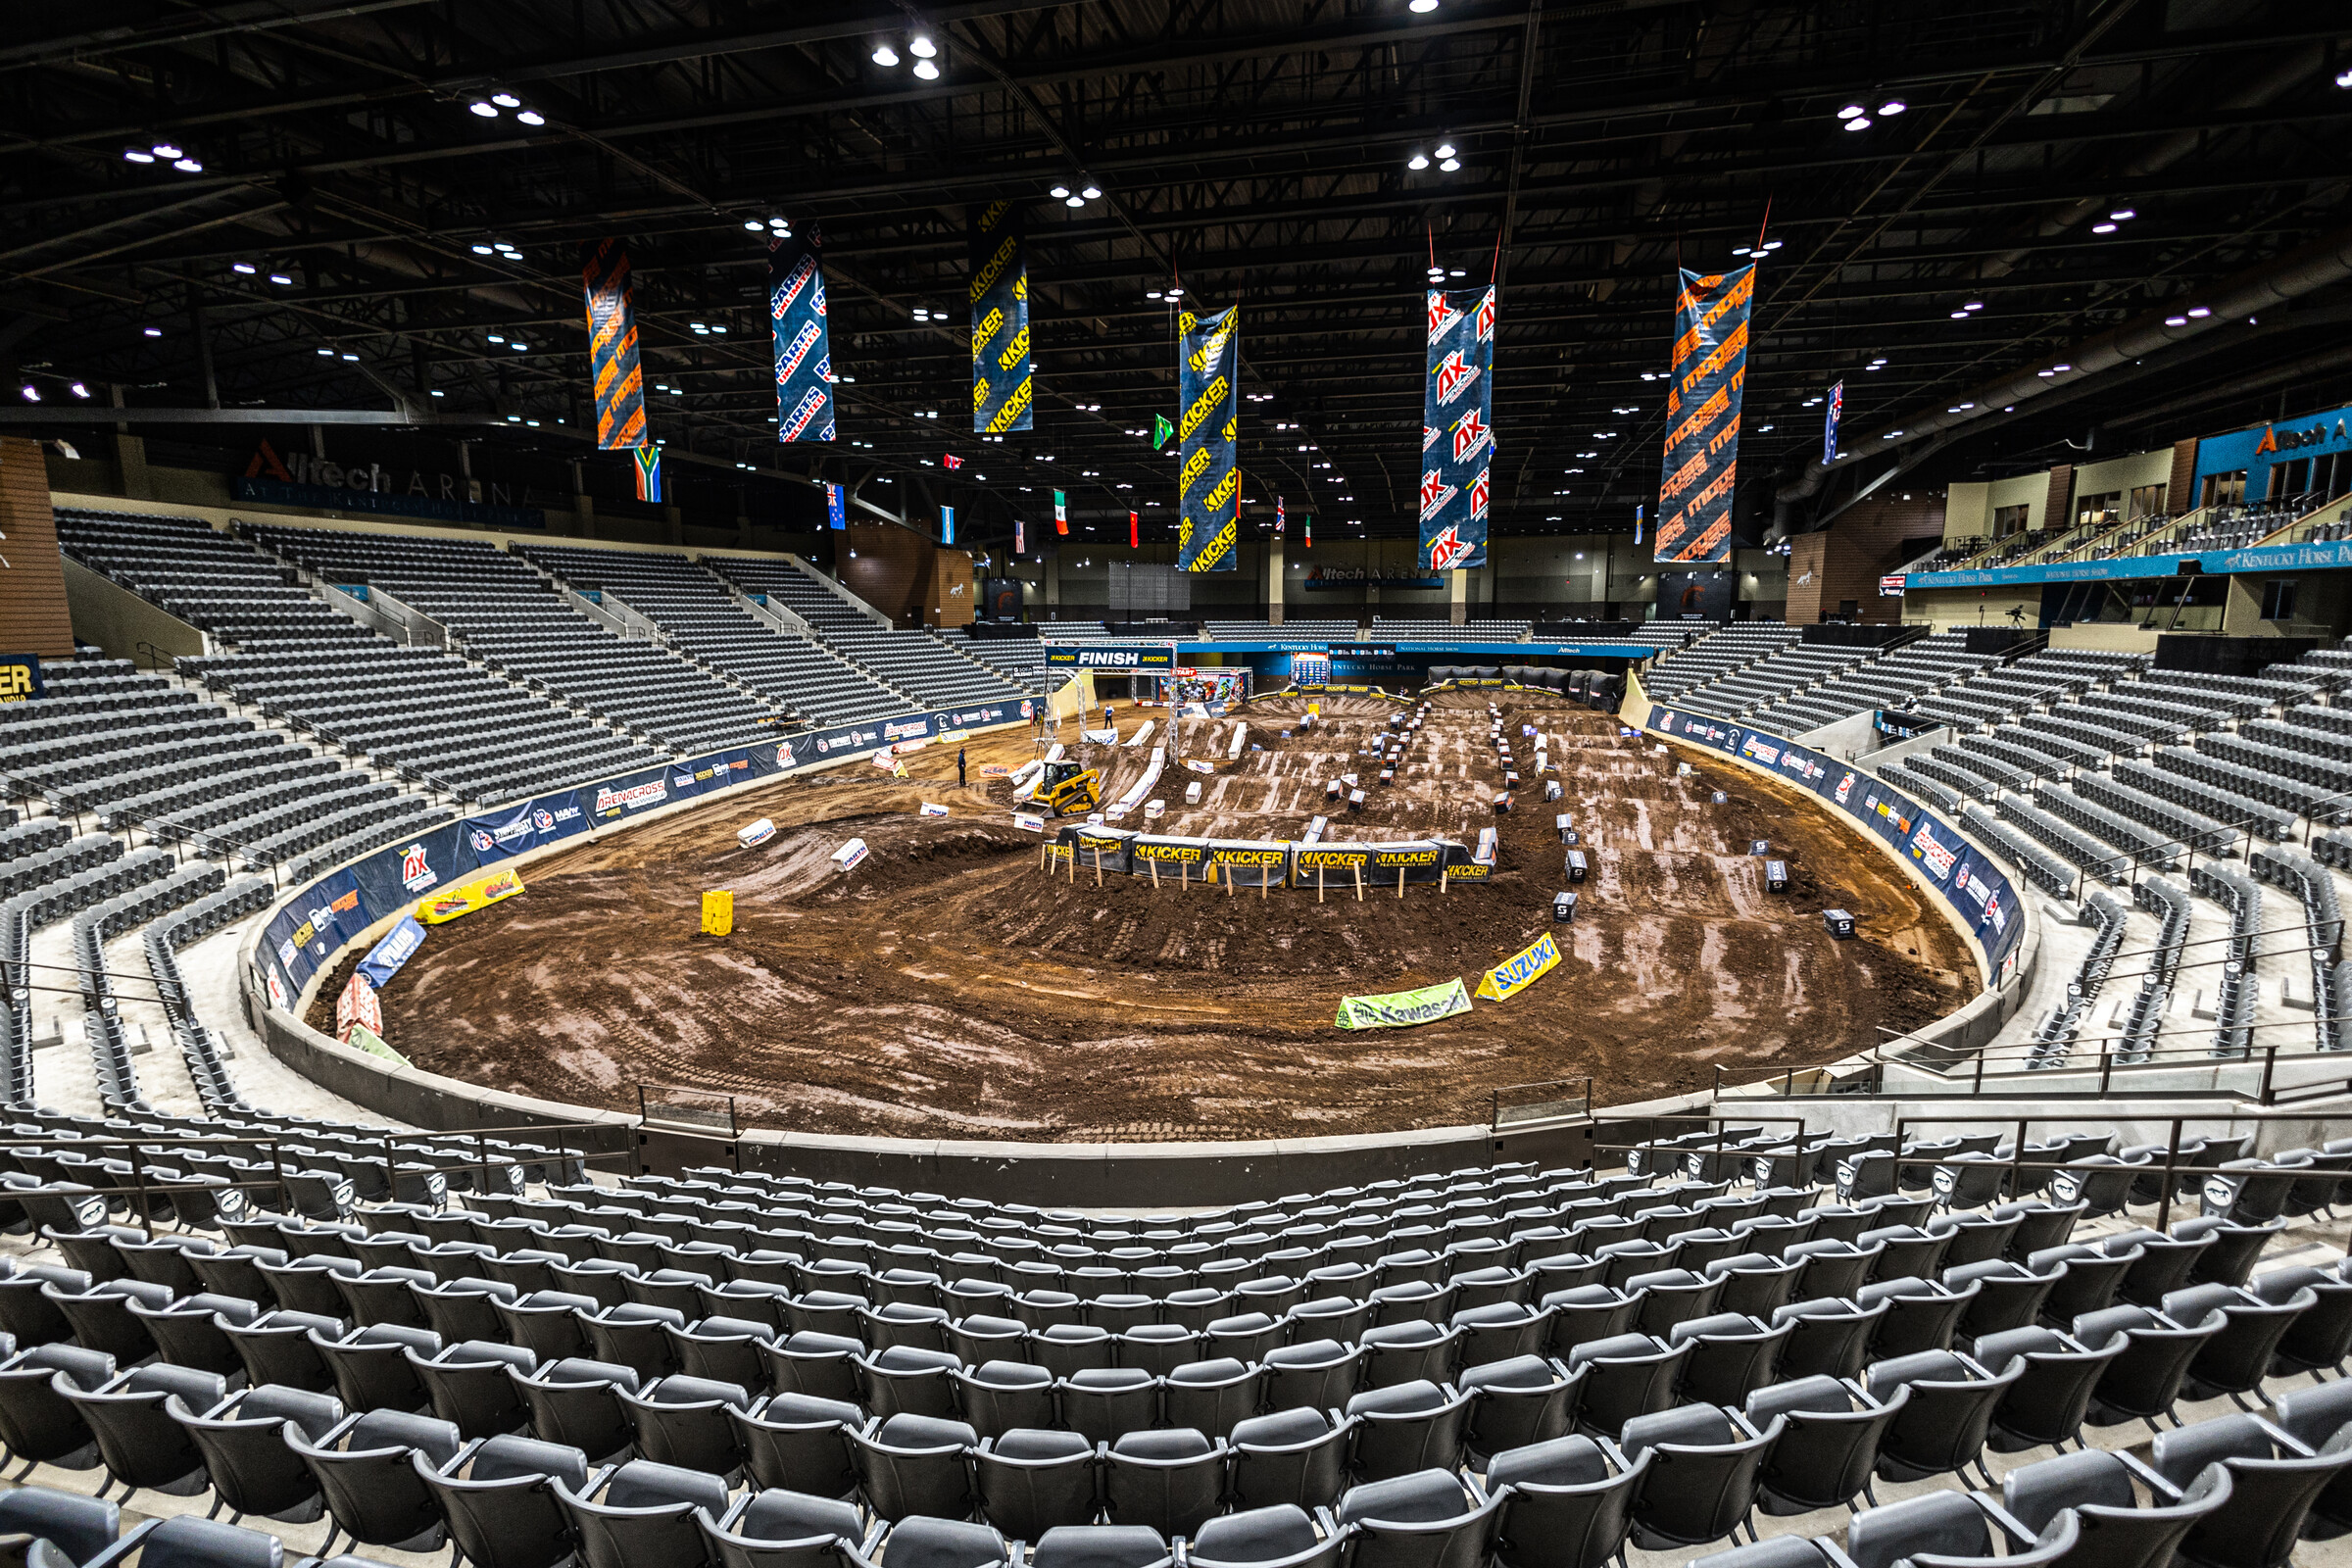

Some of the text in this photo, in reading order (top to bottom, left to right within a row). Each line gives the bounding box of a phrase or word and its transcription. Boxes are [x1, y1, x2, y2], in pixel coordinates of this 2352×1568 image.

[775, 321, 814, 378] PARTS
[778, 328, 820, 384] UNLIMITED
[1182, 374, 1229, 432] KICKER
[244, 438, 391, 494] Alltech
[2241, 548, 2335, 568] KENTUCKY HORSE
[1307, 564, 1365, 580] Alltech
[1928, 574, 1957, 585] KENTUCKY
[1958, 572, 1978, 584] HORSE
[1979, 571, 1994, 583] PARK
[1079, 652, 1139, 665] FINISH
[598, 781, 664, 809] ARENACROSS
[749, 826, 773, 842] PARTS
[844, 846, 865, 866] PARTS
[1147, 846, 1201, 861] KICKER
[1226, 851, 1284, 865] KICKER
[1311, 853, 1368, 867] KICKER
[1387, 850, 1439, 863] KICKER
[405, 851, 428, 882] AX
[1452, 864, 1489, 876] KICKER
[1495, 938, 1556, 990] SUZUKI
[1381, 990, 1469, 1024] Kawasaki
